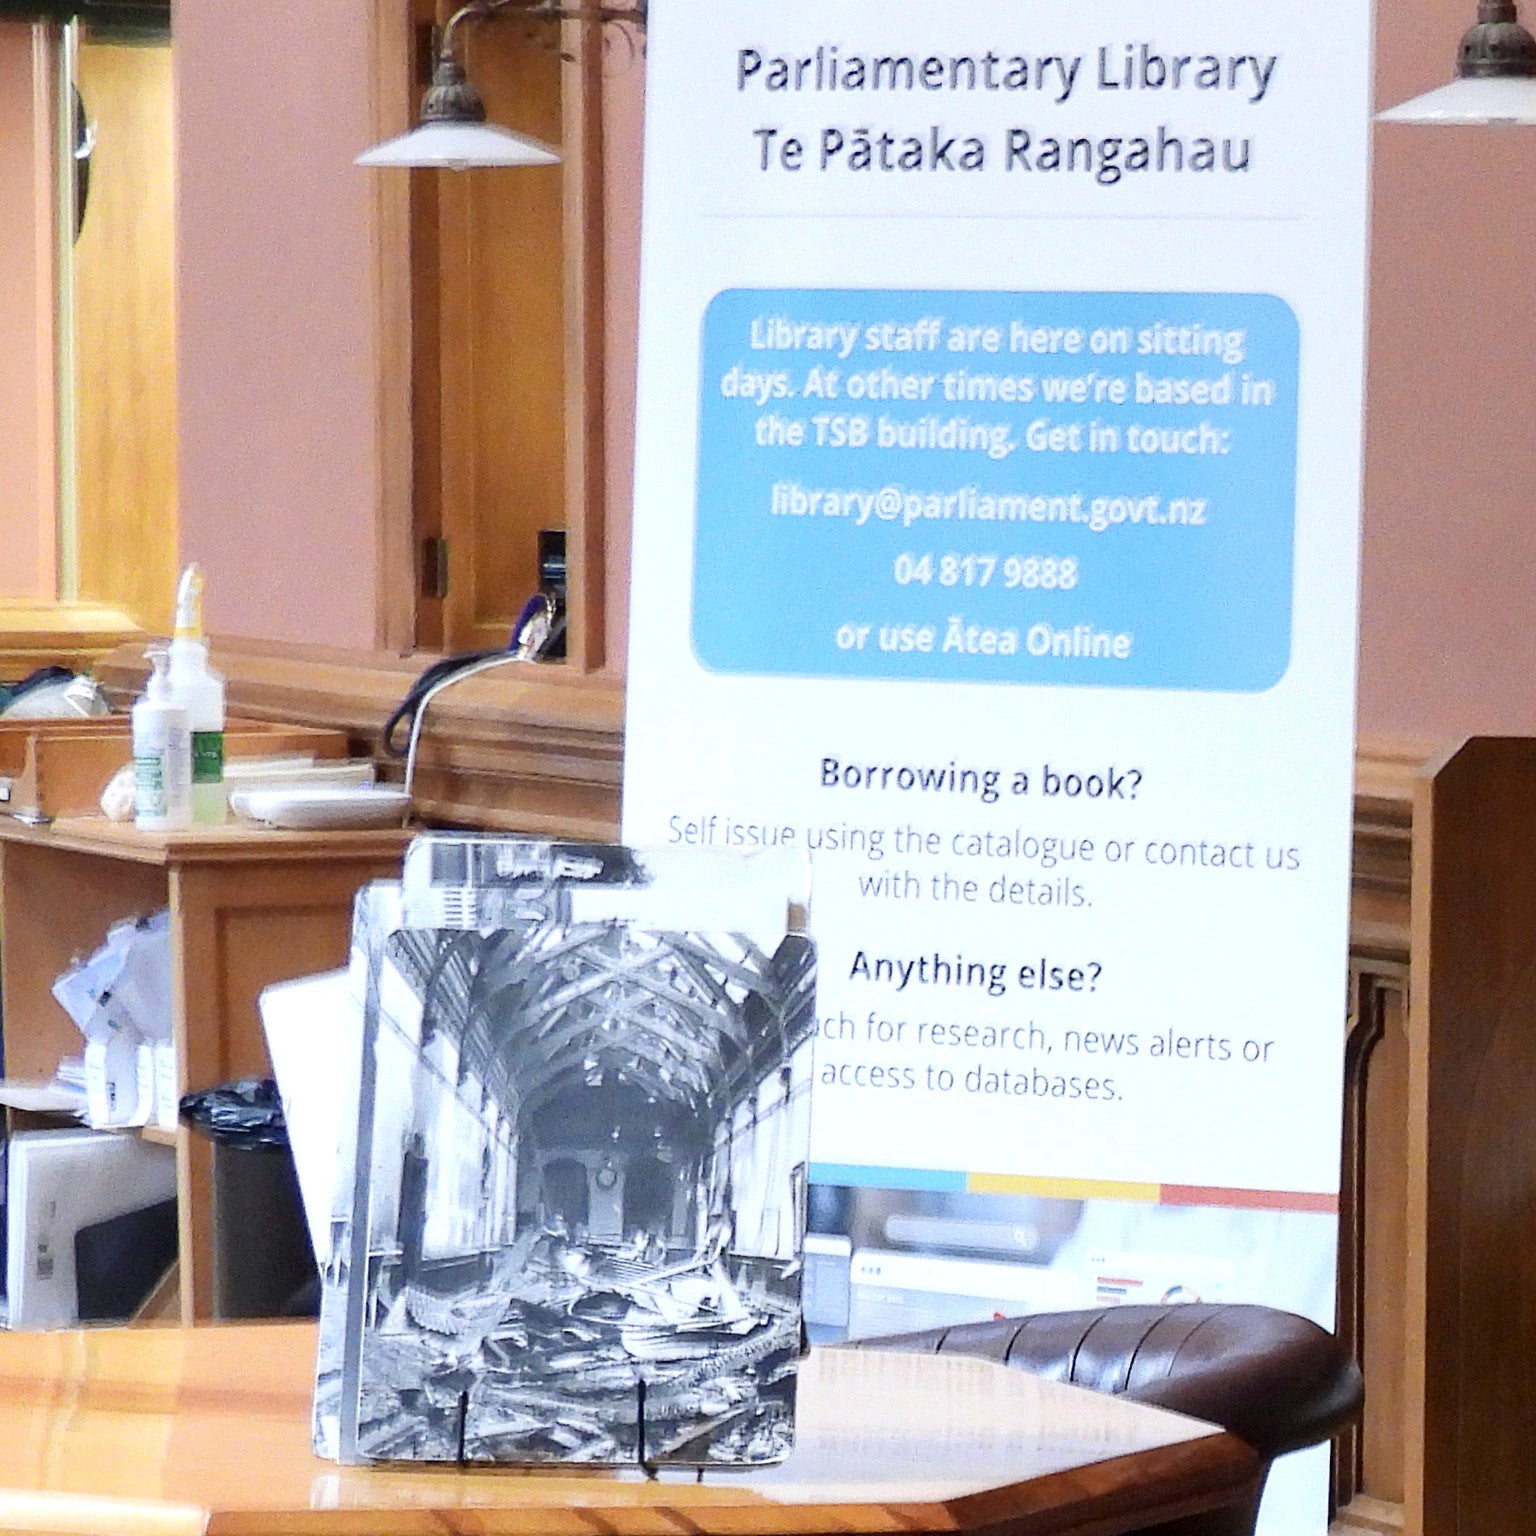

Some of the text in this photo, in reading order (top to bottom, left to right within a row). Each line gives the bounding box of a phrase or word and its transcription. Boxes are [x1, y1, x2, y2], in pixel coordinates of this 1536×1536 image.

[737, 44, 1278, 103] Parliamentary Library
[754, 127, 1251, 186] Te Pātaka Rangahau
[751, 317, 1246, 365] Library staff are here on sitting
[721, 367, 1274, 406] days. At other times we're based in
[755, 415, 1230, 459] the TSB building. Get in touch:
[771, 482, 1207, 532] library@parliament.govt.nz
[895, 554, 1076, 589] 04 817 9888
[836, 624, 870, 649] or
[879, 625, 935, 652] use
[1027, 624, 1131, 658] Online
[822, 758, 1142, 803] Borrowing a book?
[669, 815, 1300, 870] Self issue using the catalogue or contact us
[859, 870, 1092, 907] with the details.
[850, 951, 1102, 996] Anything else?
[867, 1011, 906, 1041] for
[918, 1021, 1052, 1054] research,
[1065, 1031, 1139, 1055] news
[1150, 1028, 1231, 1060] alerts
[1243, 1040, 1274, 1062] or
[822, 1064, 1122, 1100] access to databases.
